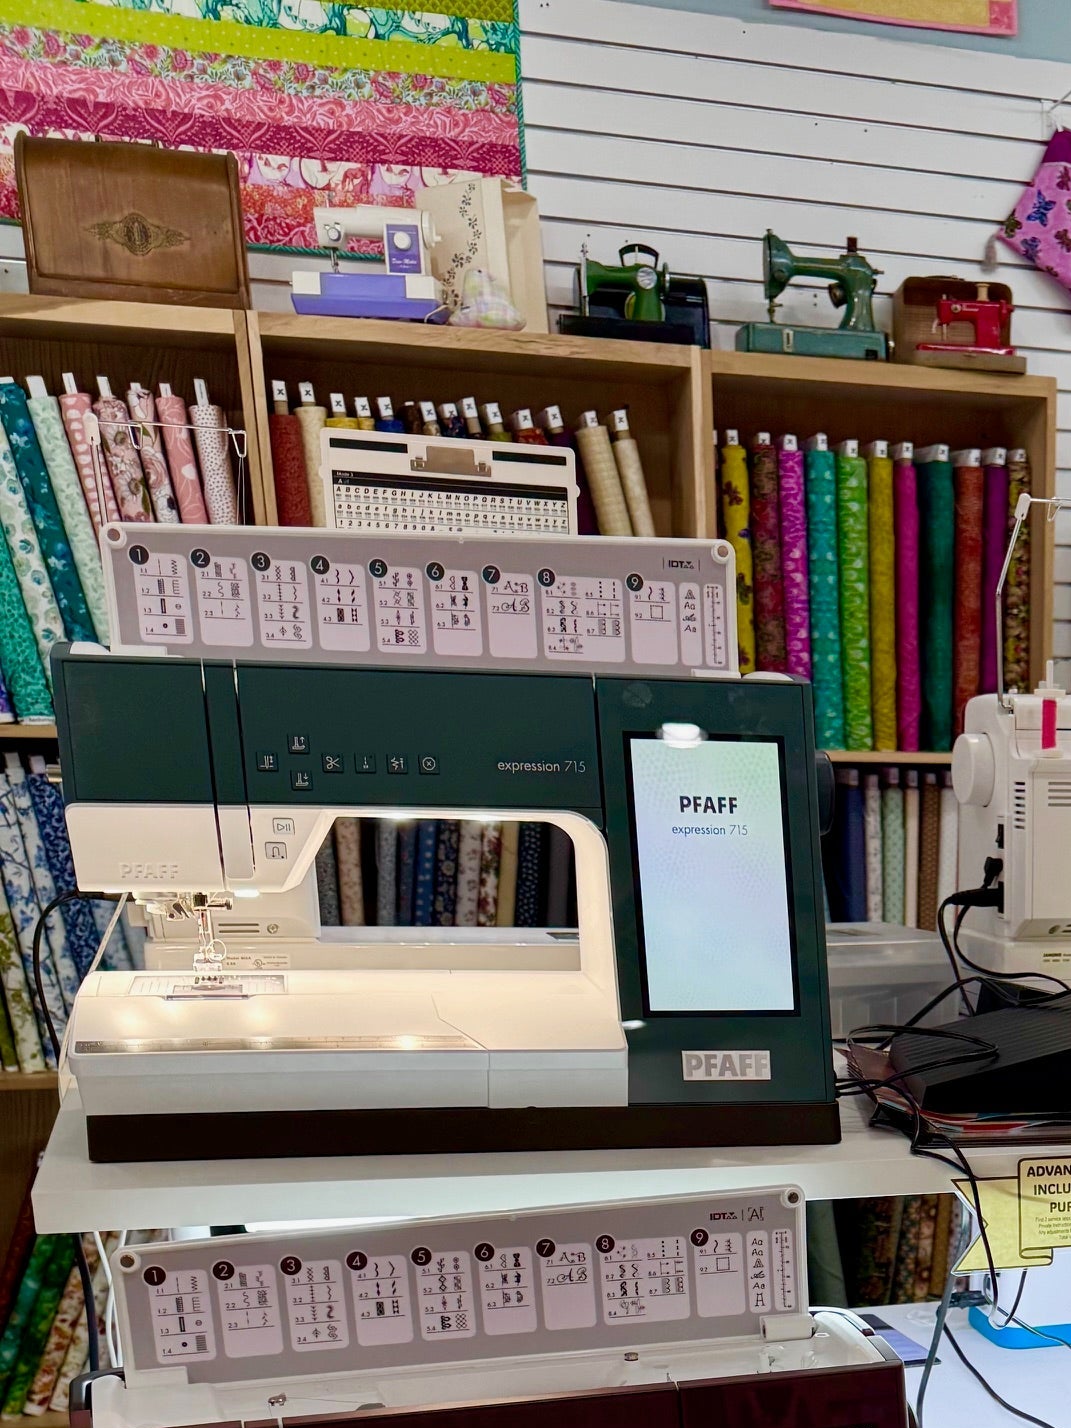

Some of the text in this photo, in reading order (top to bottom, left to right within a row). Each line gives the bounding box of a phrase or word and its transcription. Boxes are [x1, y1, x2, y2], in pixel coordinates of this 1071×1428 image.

[136, 549, 639, 589] 1 2 3 4 5 6 7 8 9
[497, 760, 586, 774] expression 715
[679, 795, 739, 814] PFAFF
[671, 824, 749, 837] expression 715
[684, 1053, 769, 1078] PFAFF
[151, 1232, 704, 1283] 1 2 3 4 5 6 7 8 9
